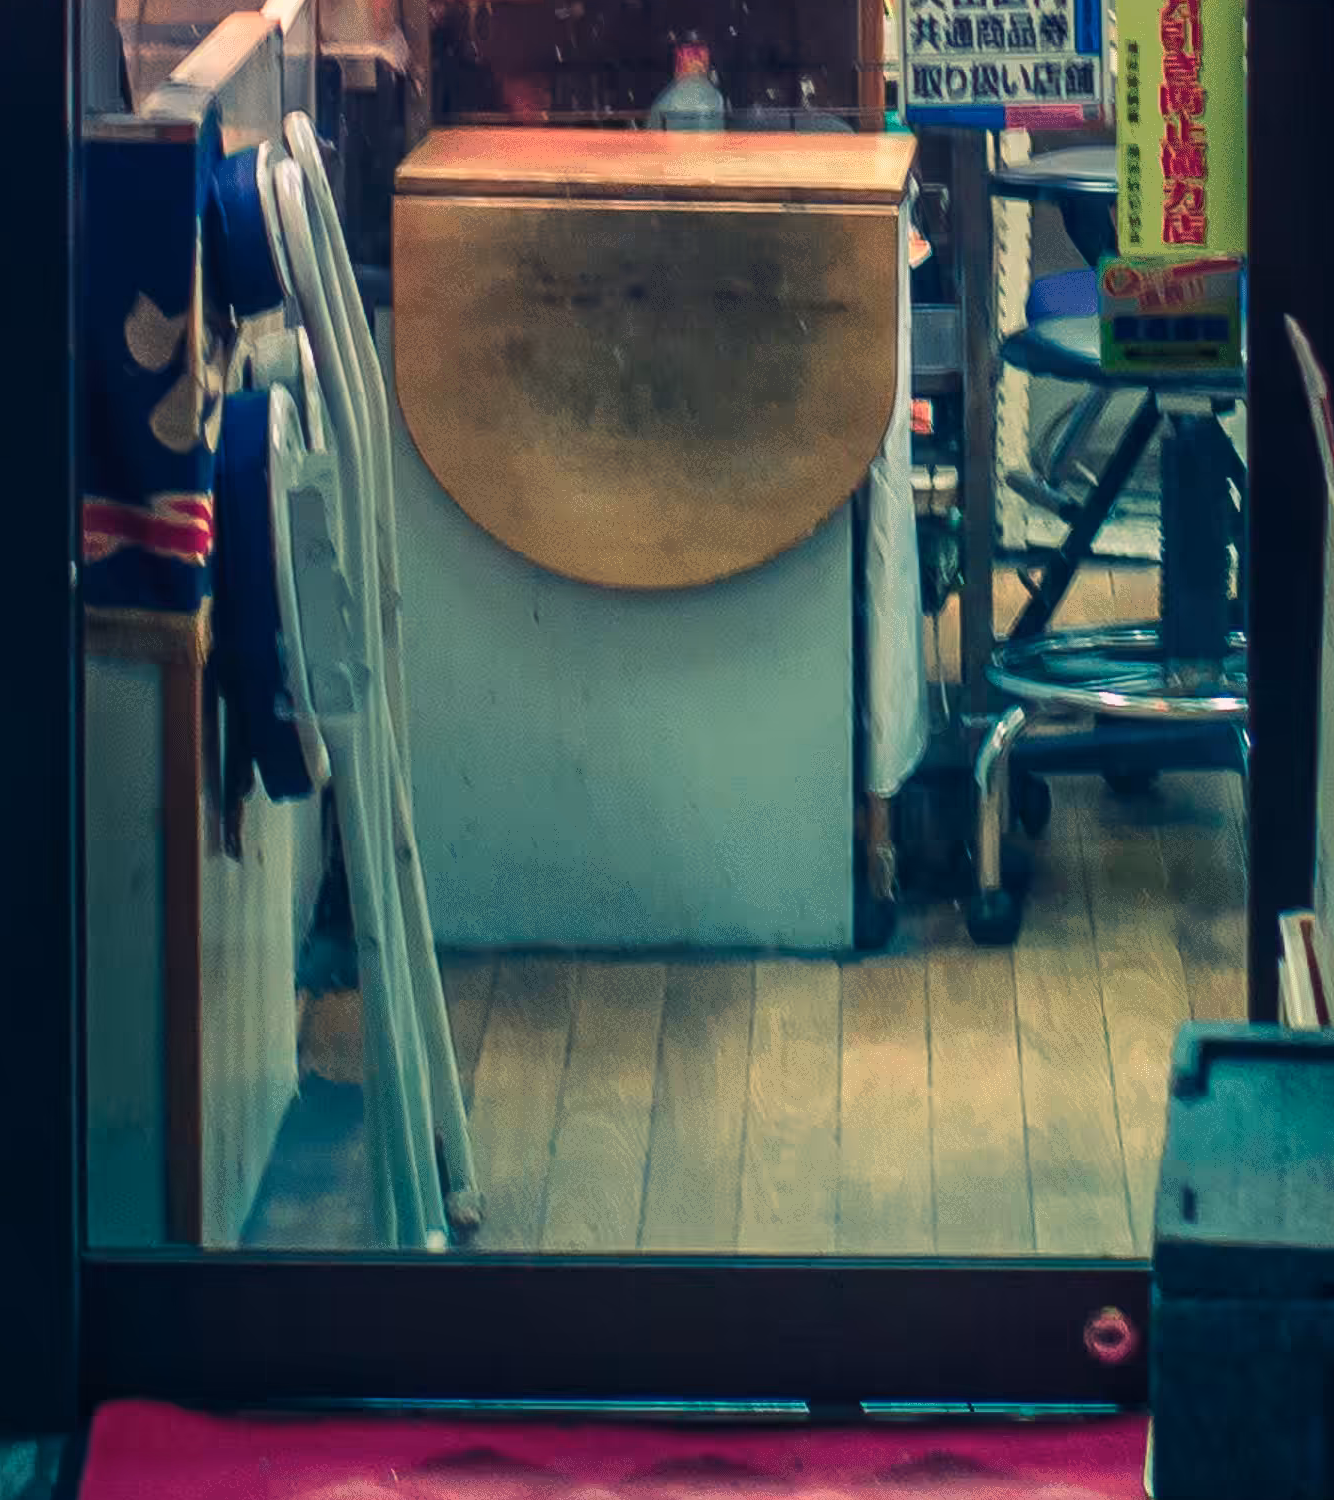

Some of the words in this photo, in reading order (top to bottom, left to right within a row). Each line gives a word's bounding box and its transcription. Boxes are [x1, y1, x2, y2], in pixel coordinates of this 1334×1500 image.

[910, 12, 1071, 52] 共通商品券
[910, 60, 1097, 100] 取り扱い店舗
